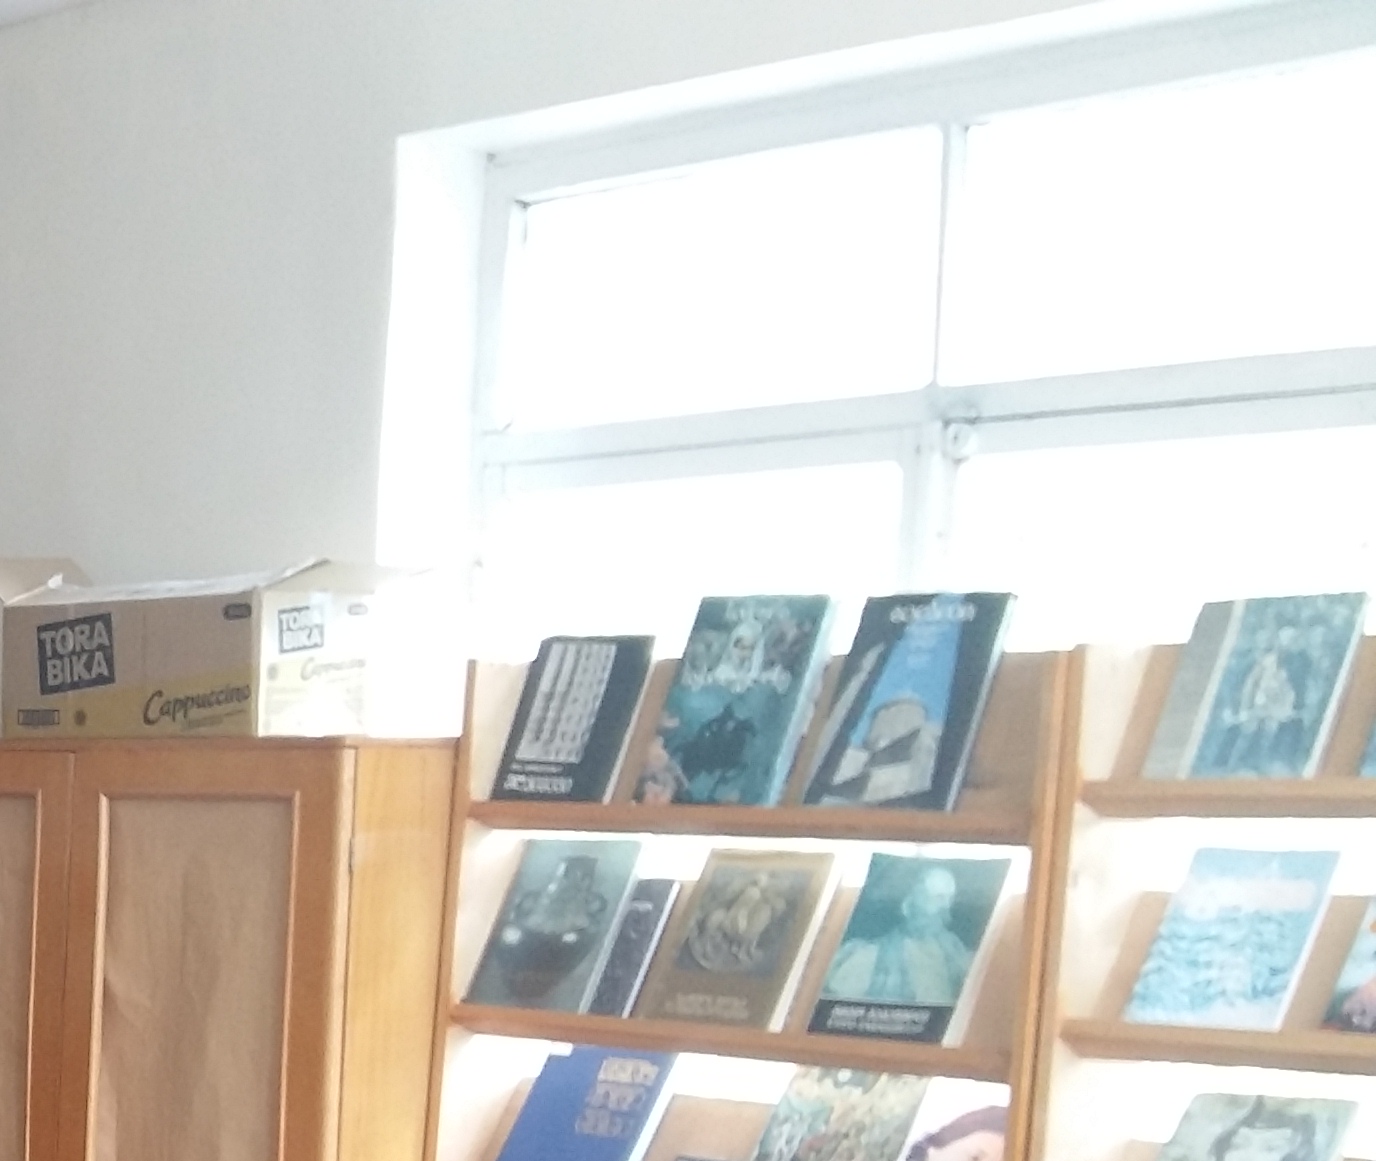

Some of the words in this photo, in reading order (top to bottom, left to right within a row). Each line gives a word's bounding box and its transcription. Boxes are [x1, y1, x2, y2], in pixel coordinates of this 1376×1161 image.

[279, 608, 323, 632] TO
[39, 621, 110, 658] TORA
[46, 651, 109, 686] BIKA
[143, 684, 252, 726] Cappuccino
